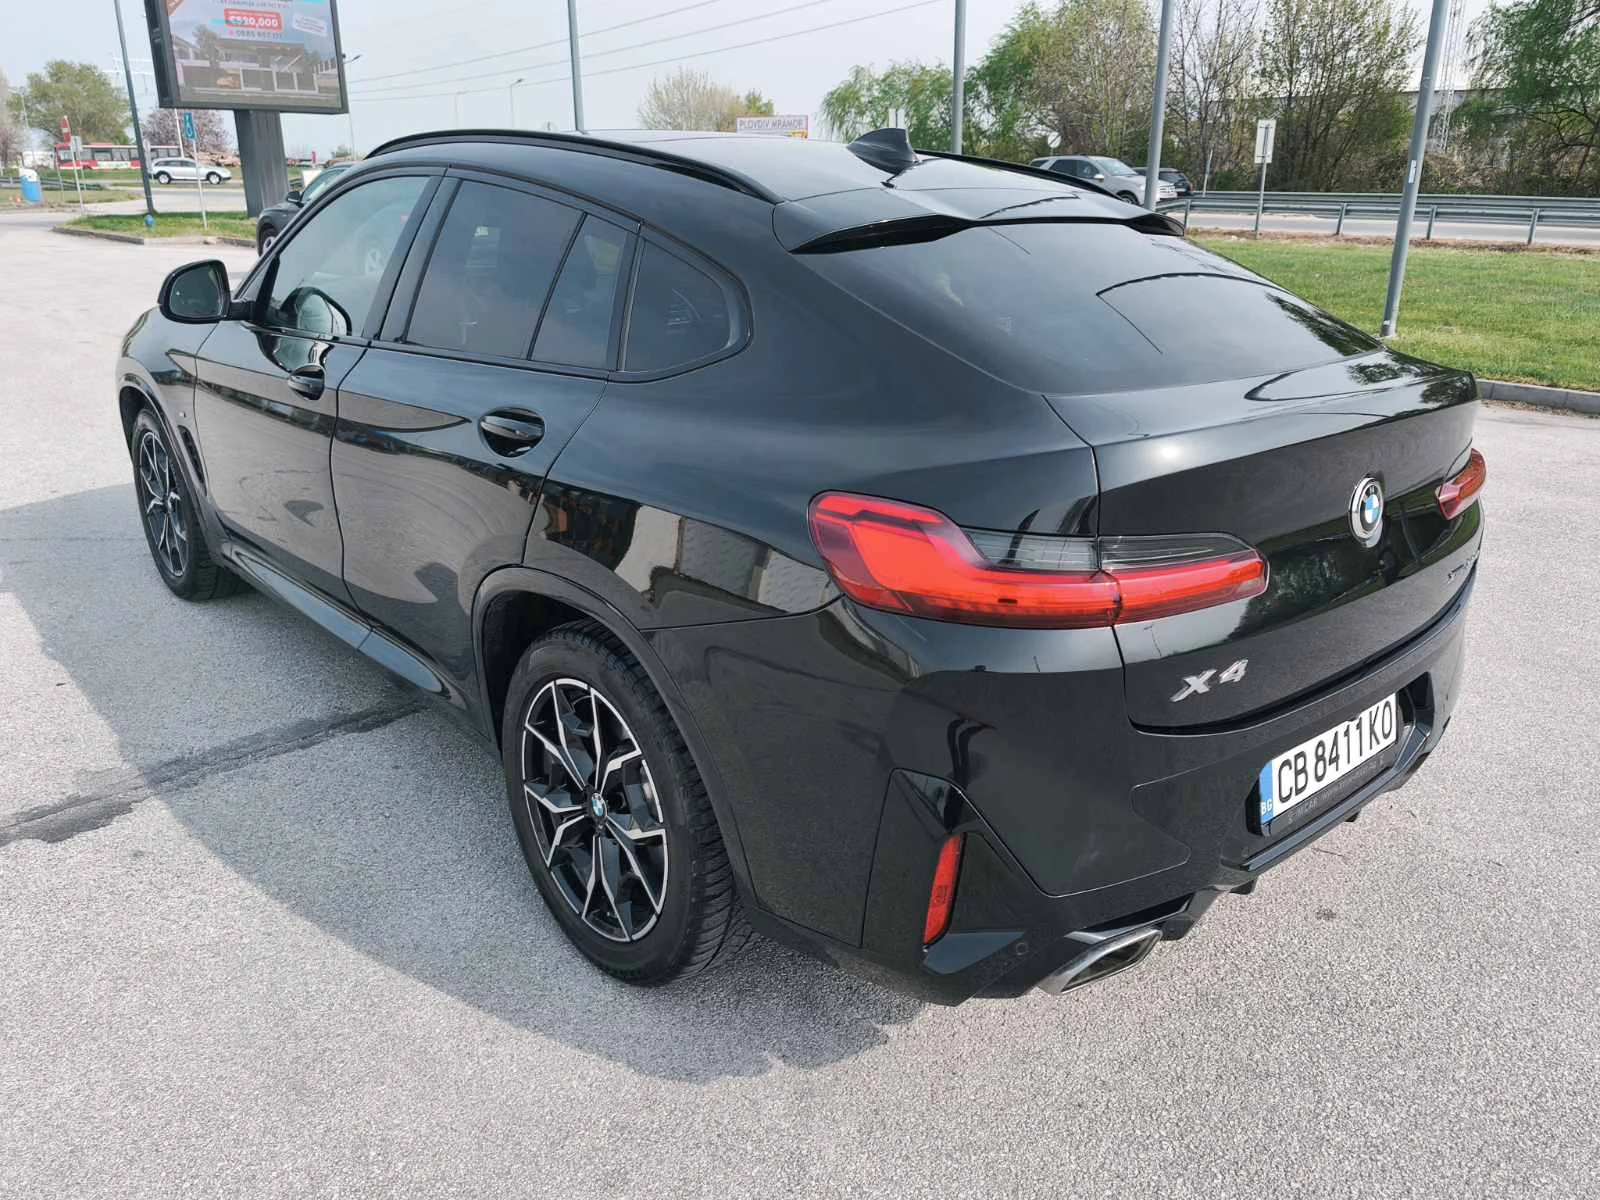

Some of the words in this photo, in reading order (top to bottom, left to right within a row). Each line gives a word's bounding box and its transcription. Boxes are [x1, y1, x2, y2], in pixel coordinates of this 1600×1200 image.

[1278, 750, 1309, 804] CB
[1314, 716, 1363, 783] 8411
[1369, 700, 1393, 750] KO
[1260, 800, 1273, 815] BG
